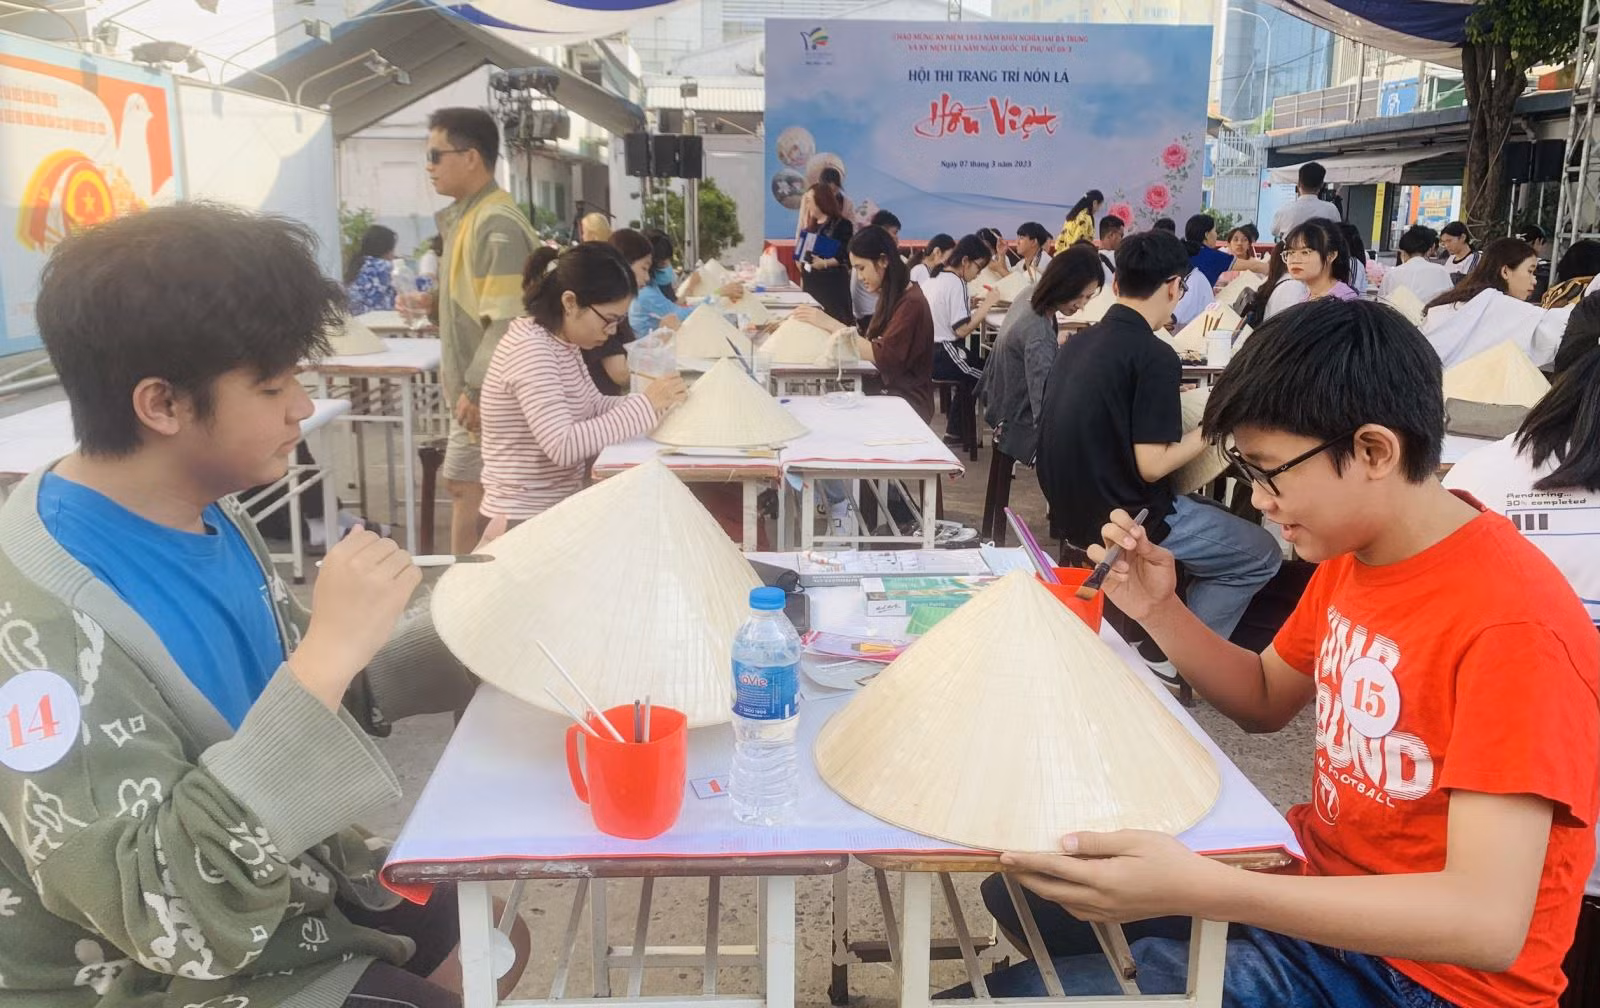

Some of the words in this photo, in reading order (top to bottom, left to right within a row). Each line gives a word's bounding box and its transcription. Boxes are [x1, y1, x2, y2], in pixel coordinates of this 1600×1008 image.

[908, 66, 930, 84] HỘI
[934, 70, 953, 82] THI
[958, 70, 997, 83] TRANG
[1001, 66, 1020, 83] TRÍ
[1023, 67, 1050, 83] NÓN
[1054, 68, 1069, 83] LÁ
[989, 96, 1059, 140] Việt
[1531, 498, 1587, 506] completed
[1350, 676, 1387, 718] 15
[1, 693, 62, 752] 14
[1328, 764, 1395, 808] FOOTBALL
